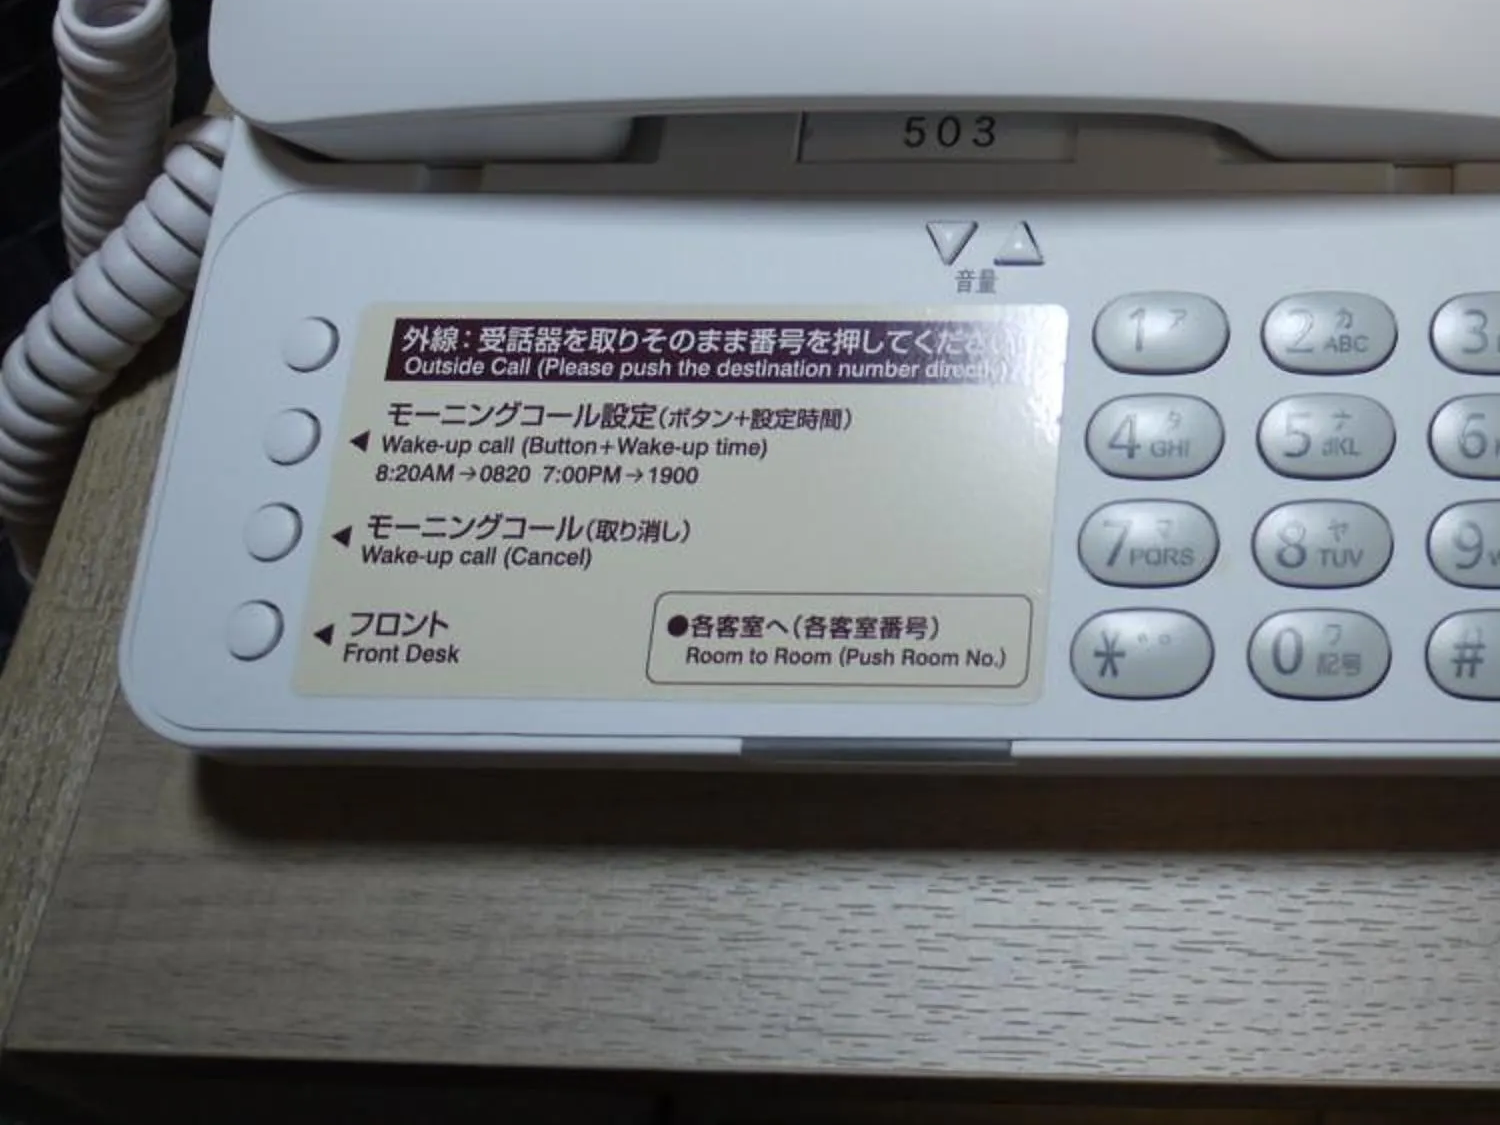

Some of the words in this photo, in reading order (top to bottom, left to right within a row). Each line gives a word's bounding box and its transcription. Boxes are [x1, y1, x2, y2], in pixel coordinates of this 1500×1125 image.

[903, 115, 997, 148] 503
[954, 269, 999, 294] 音量
[1129, 307, 1145, 353] 1
[1285, 308, 1314, 354] 2
[1461, 308, 1489, 354] 3
[1323, 334, 1369, 353] ABC
[405, 357, 484, 375] Outside
[491, 357, 530, 375] Call
[537, 358, 613, 379] (Please
[620, 359, 674, 379] push
[677, 359, 713, 376] the
[719, 360, 831, 378] destination
[839, 360, 919, 378] number
[382, 435, 472, 457] Wake-up
[478, 435, 514, 454] call
[716, 439, 768, 459] time)
[1107, 414, 1142, 460] 4
[1150, 439, 1190, 458] GHI
[1283, 412, 1312, 459] 5
[1322, 437, 1361, 457] JKL
[1459, 412, 1488, 459] 6
[1103, 520, 1133, 567] 7
[1276, 521, 1307, 569] 8
[1453, 521, 1483, 570] 9
[362, 546, 453, 569] Wake-up
[460, 547, 497, 565] call
[504, 547, 593, 570] (Cancel)
[1129, 547, 1194, 567] PQRS
[1317, 548, 1363, 568] TUV
[349, 611, 449, 638] フロント
[343, 644, 399, 663] Front
[406, 644, 460, 663] Desk
[686, 647, 743, 665] Room
[749, 648, 768, 665] to
[774, 647, 832, 666] Room
[839, 648, 895, 668] (Push
[901, 649, 959, 667] Room
[966, 649, 1006, 669] No.)
[1272, 627, 1303, 675] 0
[1316, 654, 1362, 675] 記号
